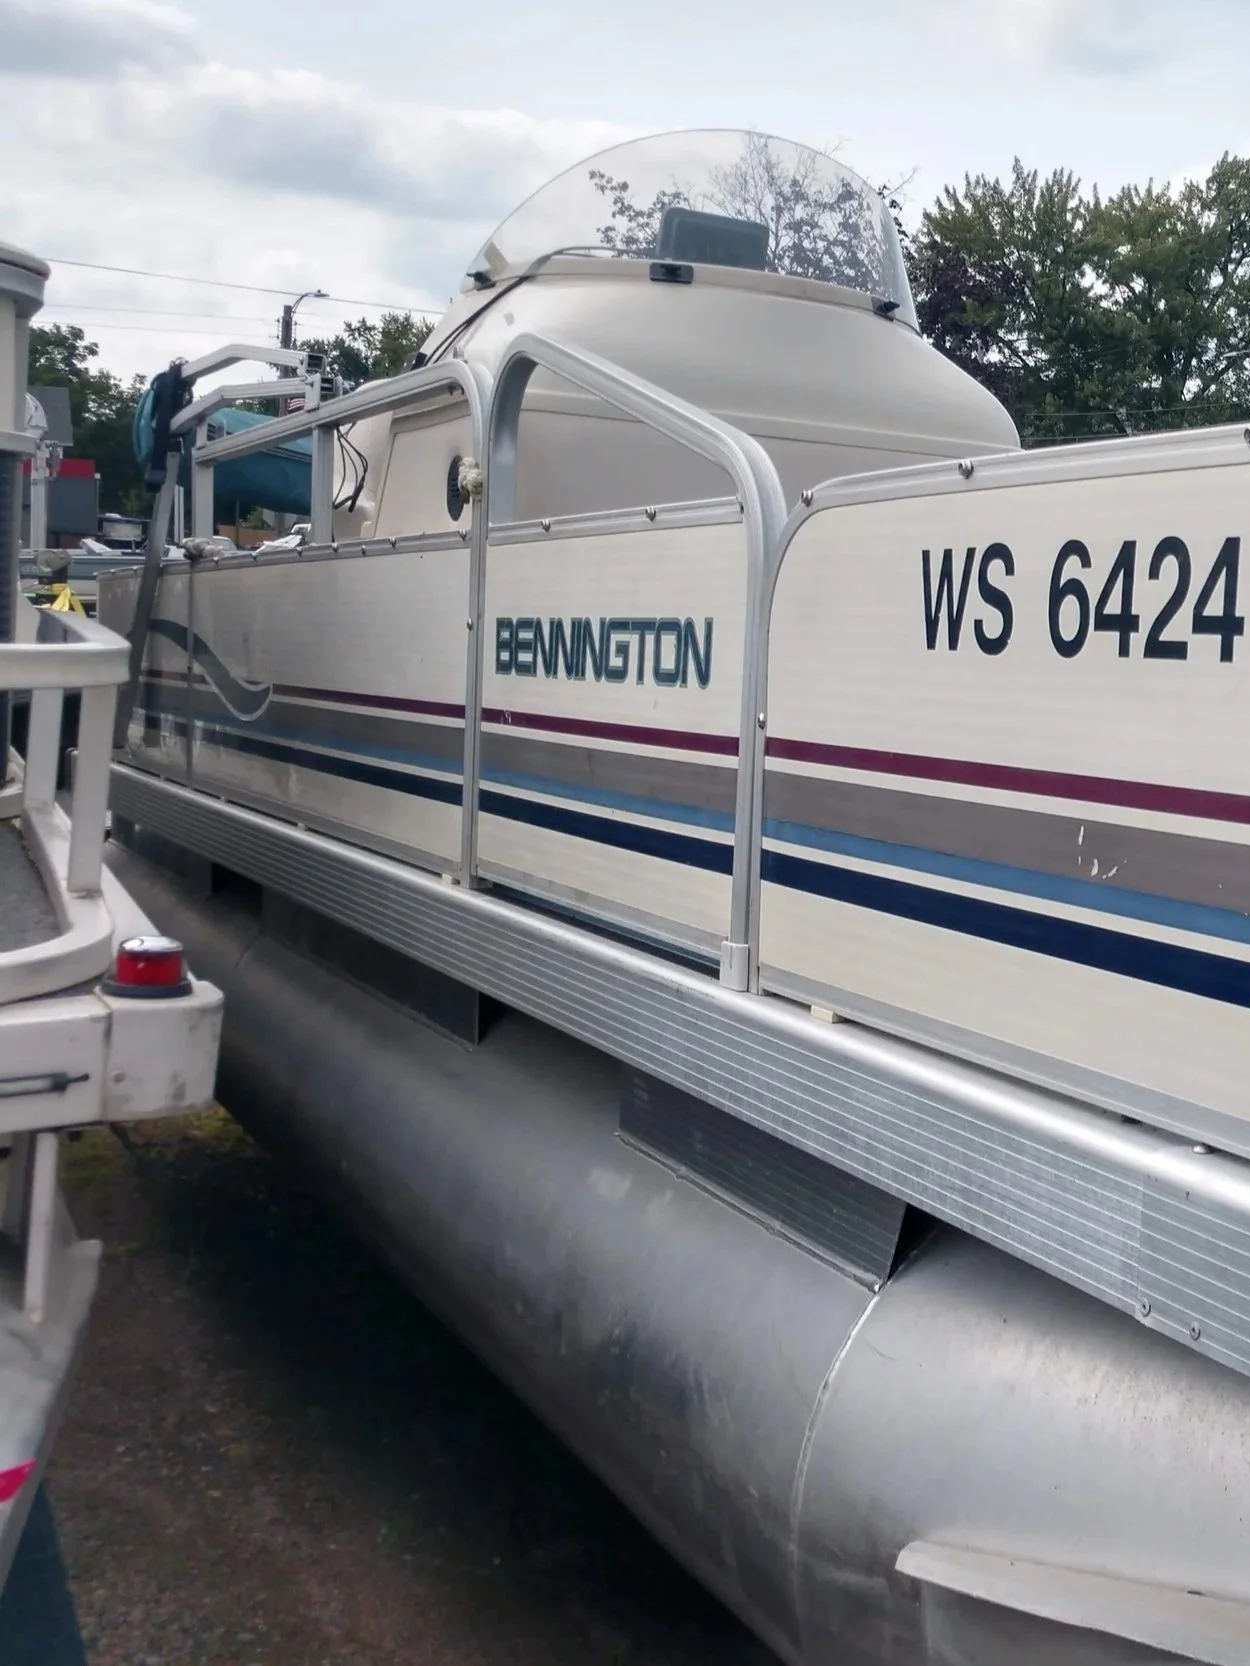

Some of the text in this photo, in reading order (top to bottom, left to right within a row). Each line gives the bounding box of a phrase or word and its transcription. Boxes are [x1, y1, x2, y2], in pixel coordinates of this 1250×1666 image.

[922, 541, 1016, 656] WS
[1047, 535, 1246, 663] 6424
[495, 617, 714, 690] BENNINGTON
